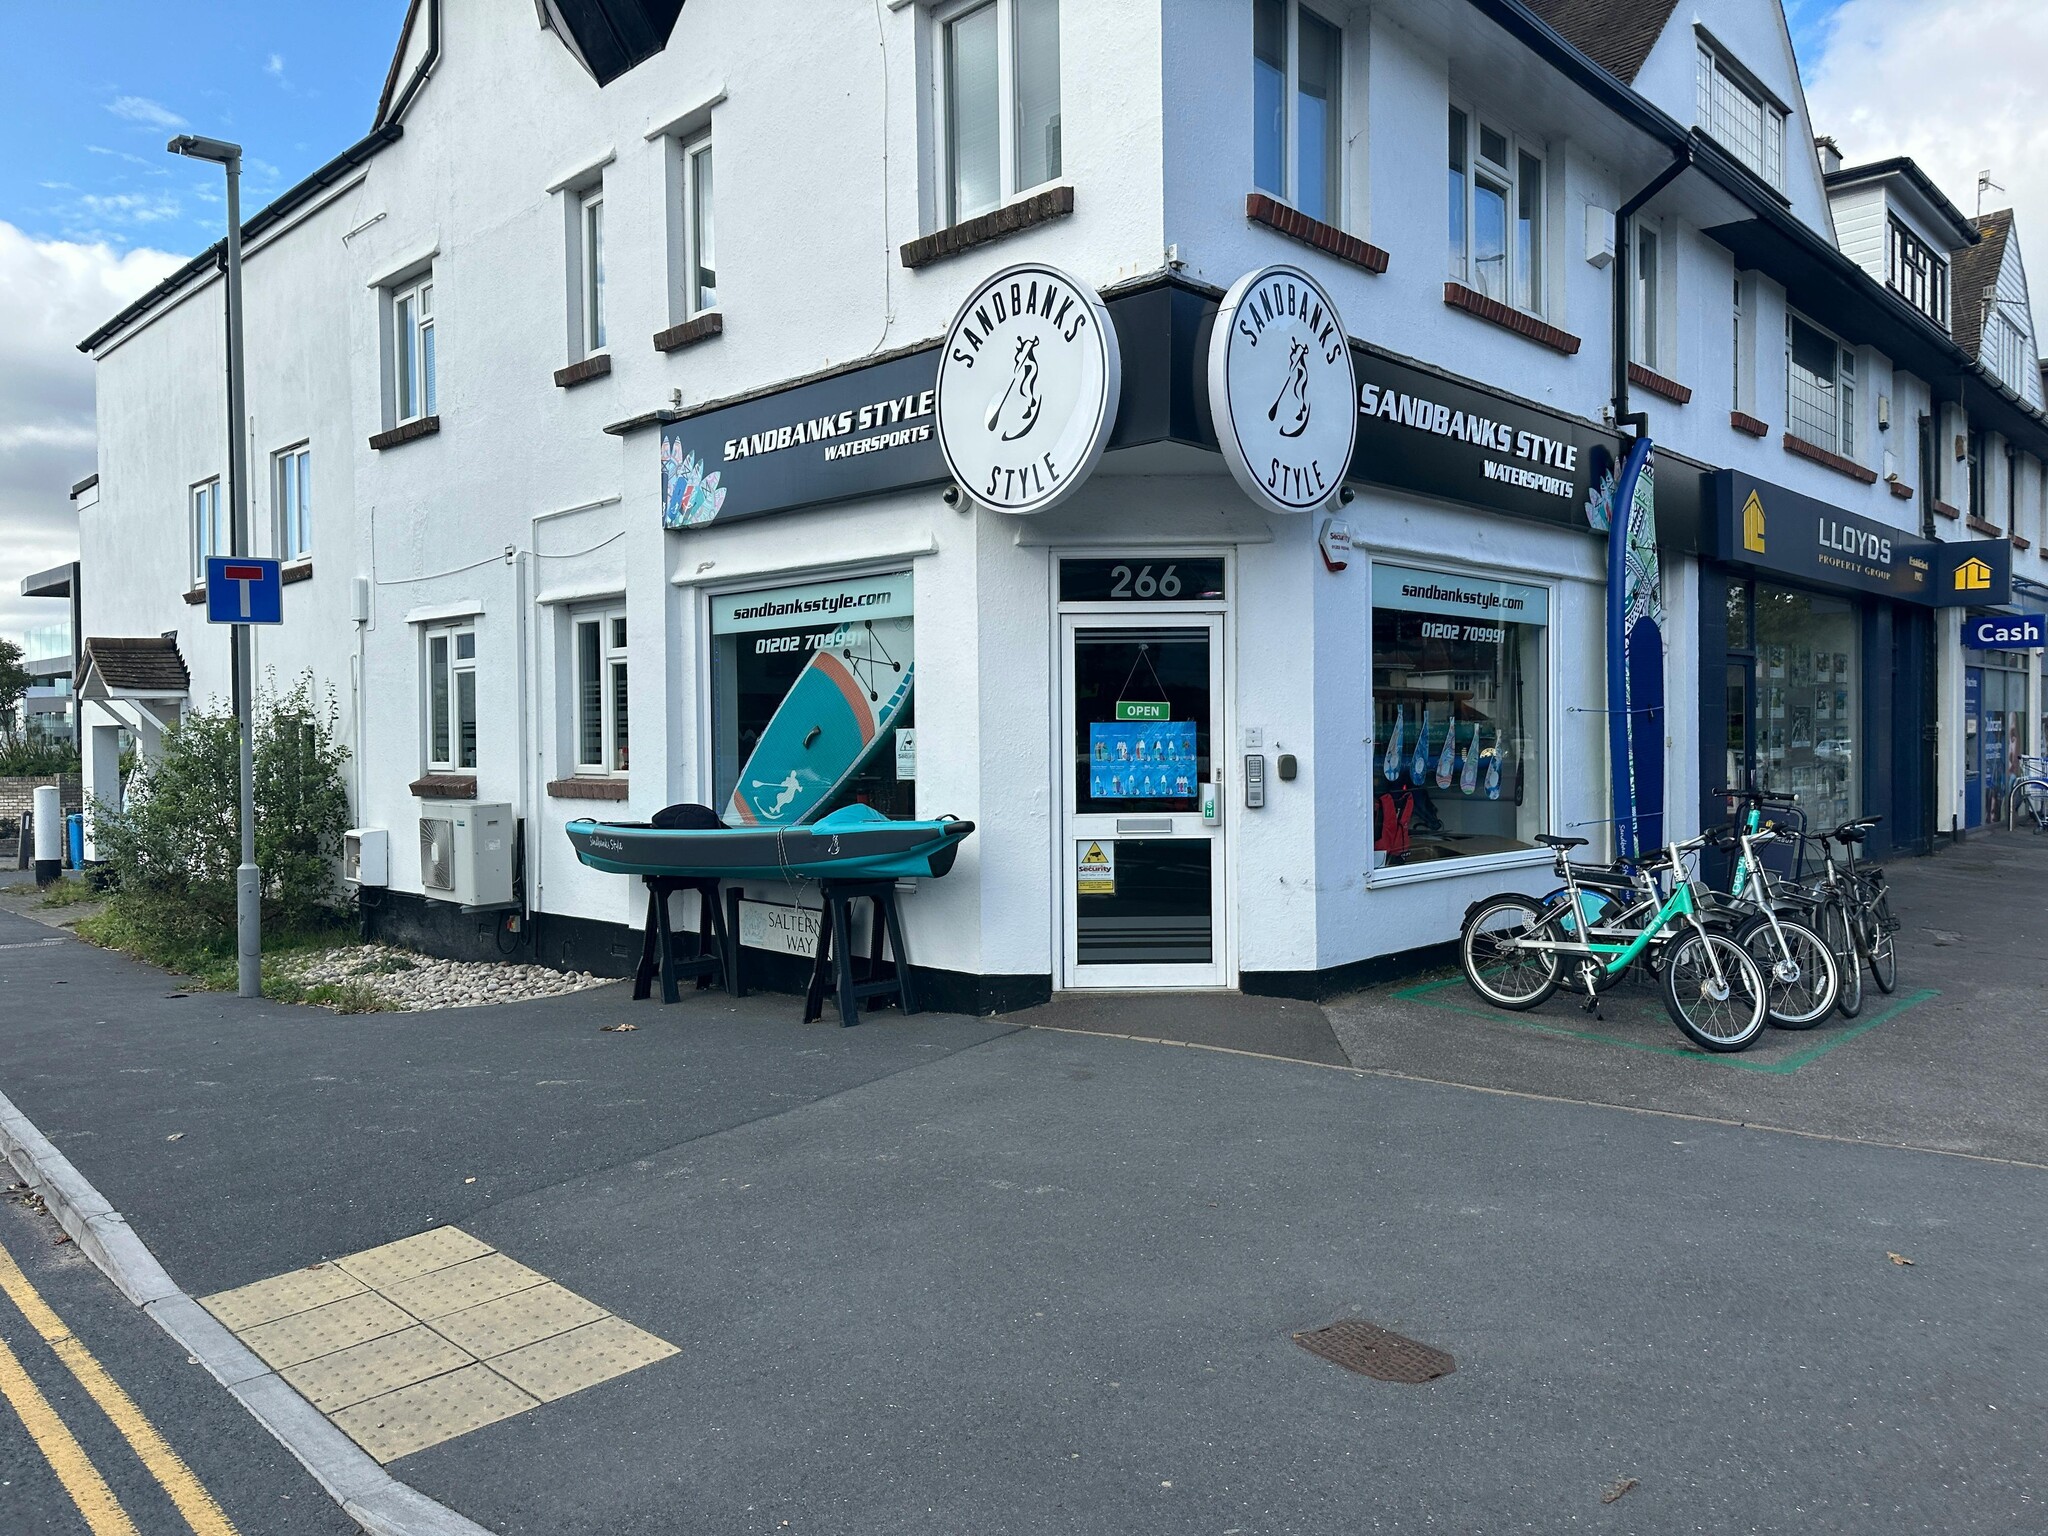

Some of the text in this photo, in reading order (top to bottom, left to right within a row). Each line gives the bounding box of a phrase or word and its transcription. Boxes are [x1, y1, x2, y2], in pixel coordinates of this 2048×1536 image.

[953, 281, 1086, 368] SANDBANKS
[1240, 283, 1342, 365] SANDBANKS
[724, 390, 934, 462] SANDBANKS STYLE
[1360, 383, 1578, 472] SANDBANKS STYLE
[824, 425, 931, 461] WATERSPORTS
[986, 452, 1060, 500] STYLE
[1268, 457, 1325, 499] STYLE
[1484, 460, 1574, 498] WATERSPORTS
[1819, 517, 1891, 564] LLOYDS
[1110, 565, 1181, 598] 266
[1818, 554, 1891, 580] PROPERTY GROUP
[733, 588, 892, 622] sandbanksstyle.com
[1401, 584, 1524, 610] sandbanksstyle.com
[755, 630, 863, 654] 01202 709991
[1421, 622, 1506, 643] 01202 709991
[1977, 621, 2039, 642] Cash
[1126, 705, 1160, 717] OPEN
[610, 839, 623, 853] Style
[768, 911, 821, 934] SALTERN
[1643, 914, 1663, 937] beryl
[786, 934, 813, 953] WAY
